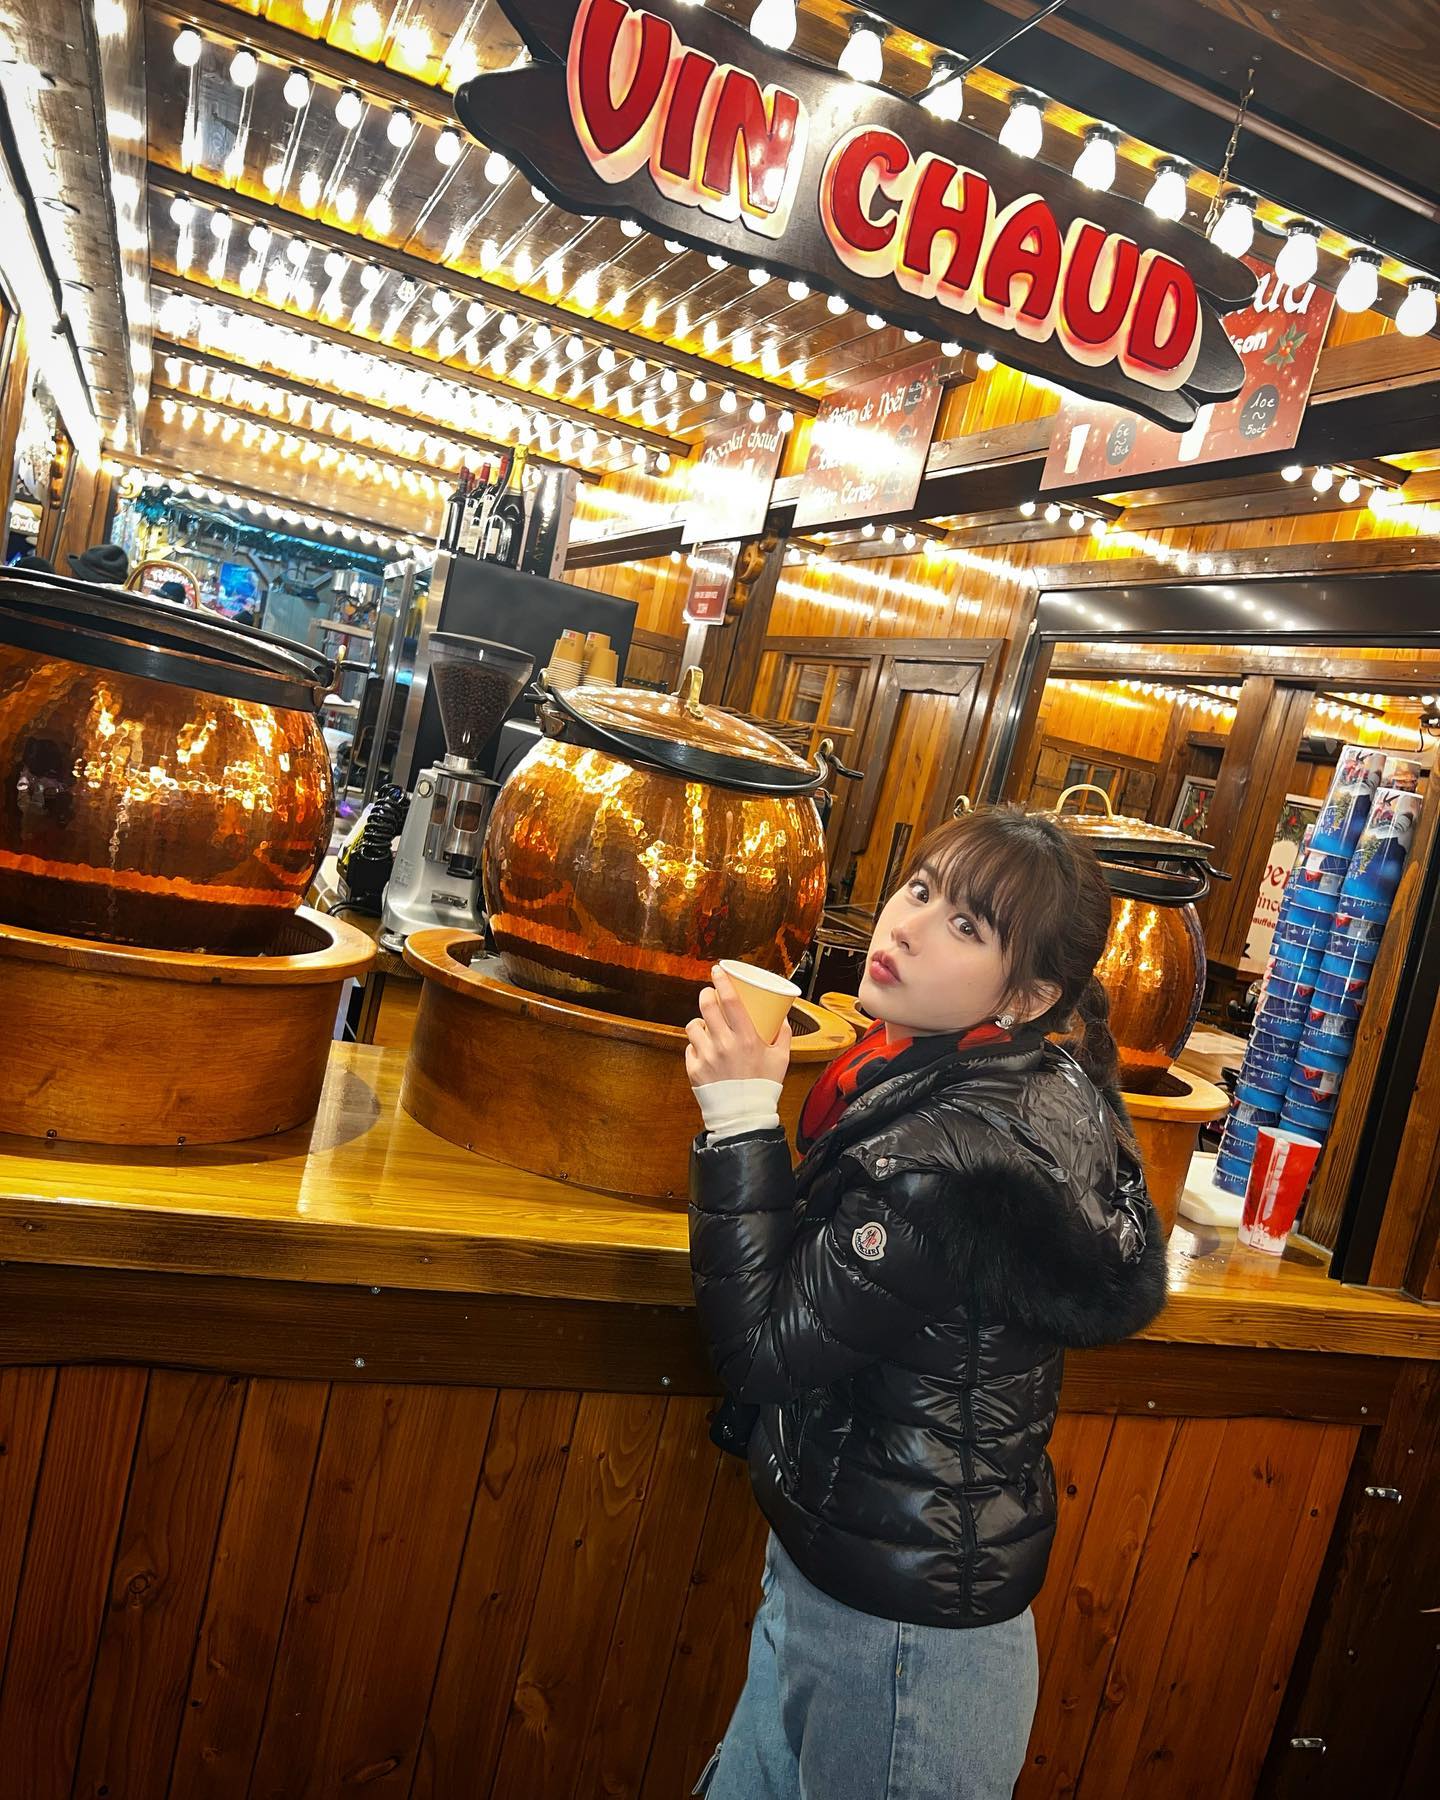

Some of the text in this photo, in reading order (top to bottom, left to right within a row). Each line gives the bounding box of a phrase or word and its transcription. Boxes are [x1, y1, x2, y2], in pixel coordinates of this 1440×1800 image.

[575, 0, 1199, 374] VIN CHAUD
[859, 396, 875, 422] de
[877, 384, 907, 417] Noël
[747, 424, 782, 454] chaud
